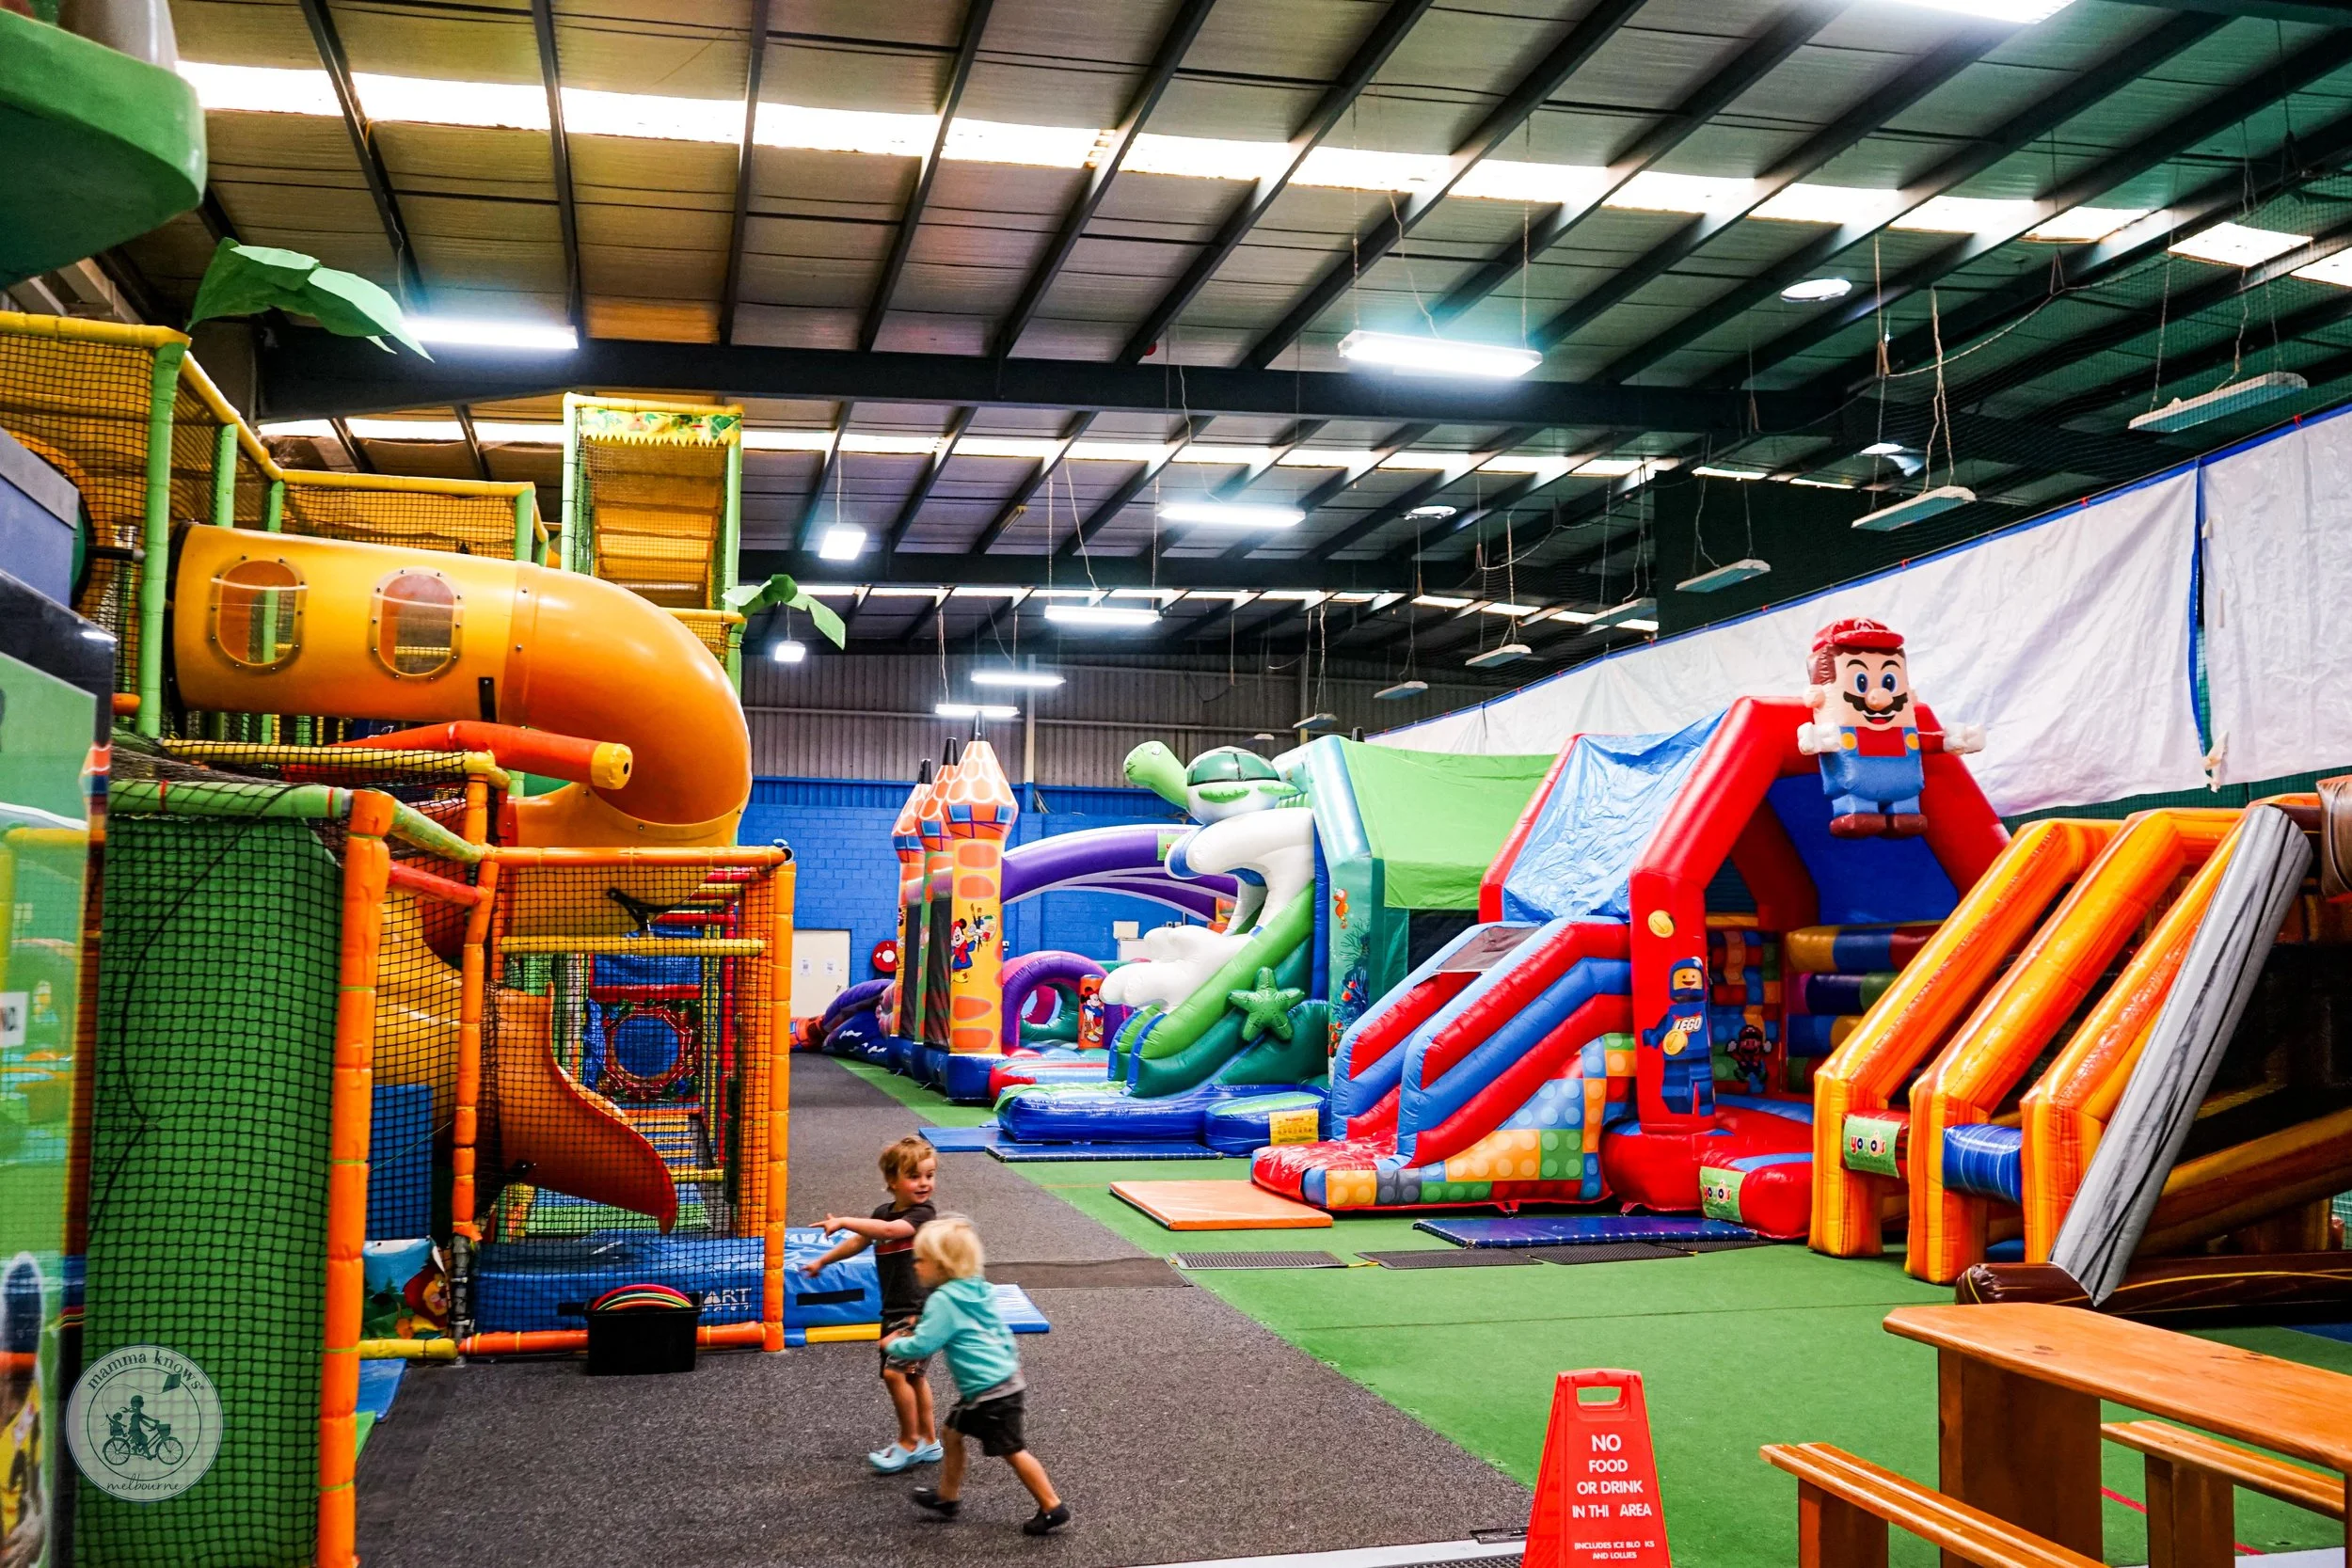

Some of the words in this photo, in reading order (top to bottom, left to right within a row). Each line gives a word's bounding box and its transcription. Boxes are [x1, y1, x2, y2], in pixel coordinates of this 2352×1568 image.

[703, 1288, 752, 1305] ART
[1591, 1433, 1622, 1452] NO
[1588, 1459, 1629, 1473] FOOD
[1577, 1481, 1597, 1495] OR
[1600, 1480, 1644, 1495] DRINK
[1572, 1504, 1585, 1518] IN
[1588, 1504, 1610, 1518] THI
[1619, 1503, 1652, 1517] AREA
[1613, 1541, 1625, 1549] ICE
[1610, 1551, 1637, 1560] LOLLIES
